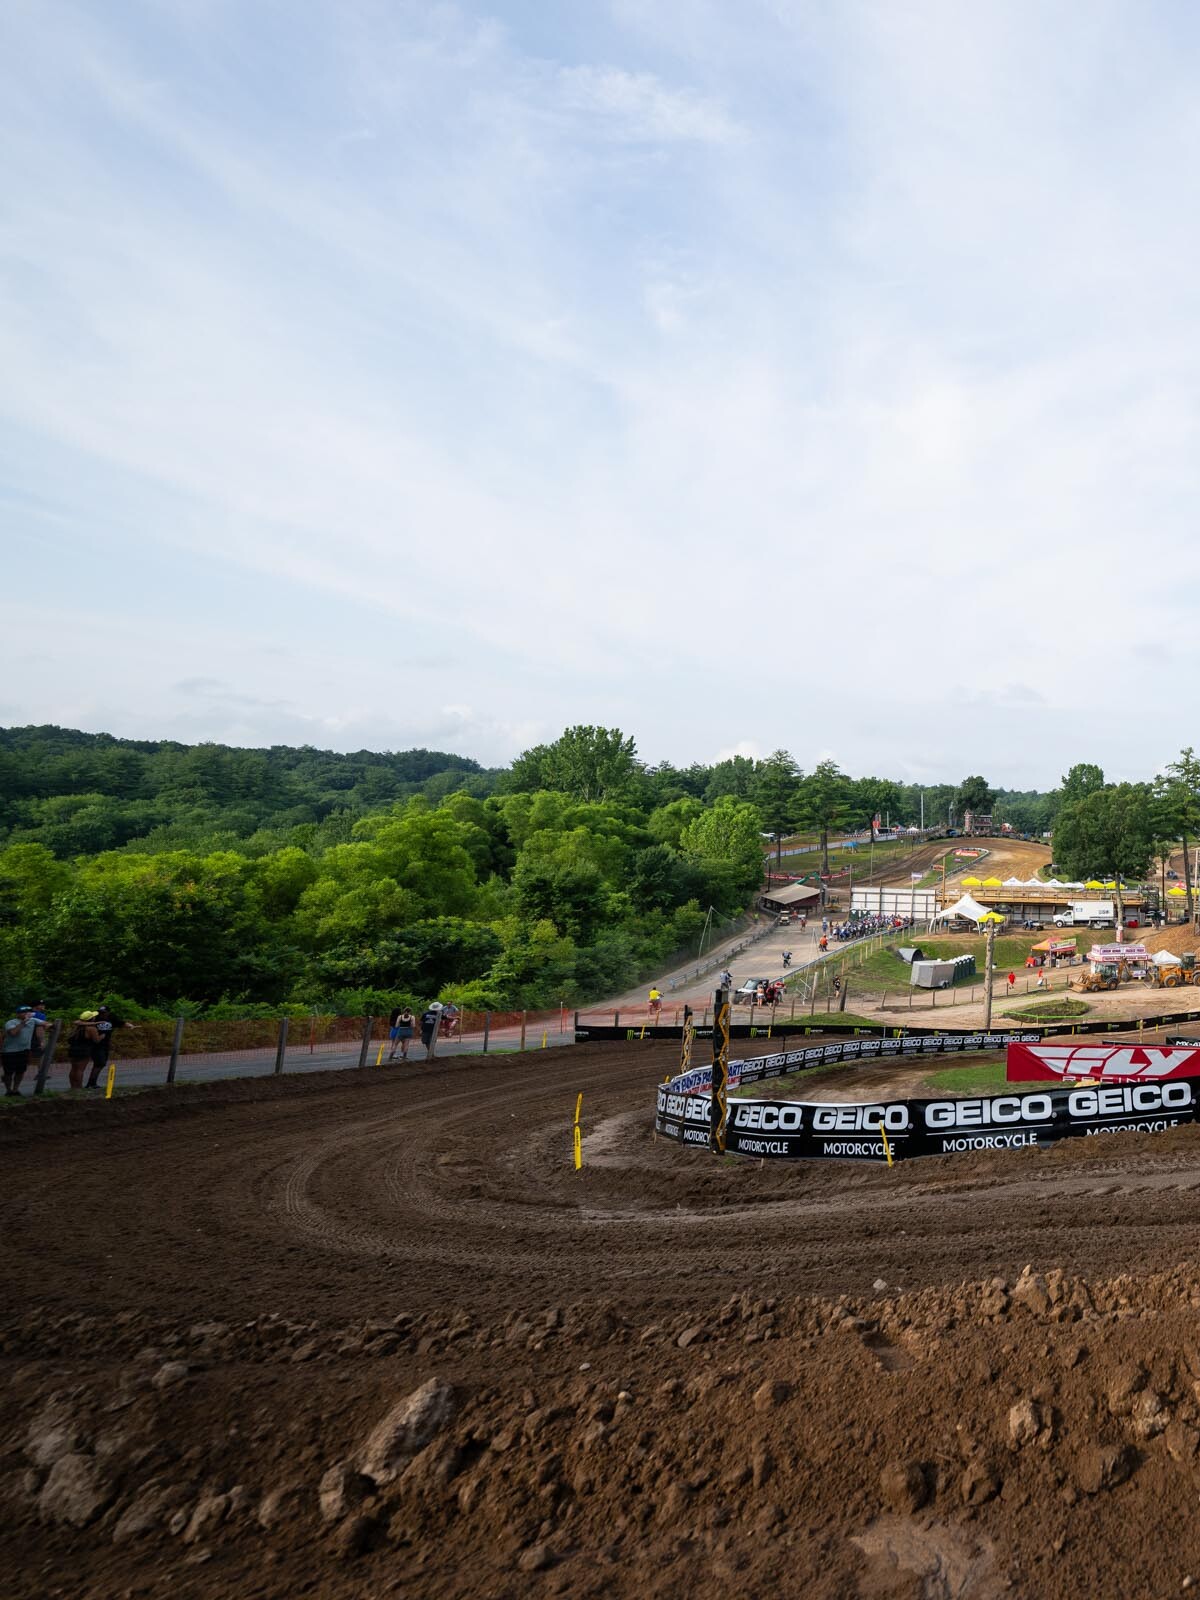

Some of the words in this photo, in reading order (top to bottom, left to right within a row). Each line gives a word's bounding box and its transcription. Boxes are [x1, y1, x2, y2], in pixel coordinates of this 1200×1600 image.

[742, 1060, 763, 1073] GEICO
[765, 1055, 785, 1068] GEICO
[786, 1051, 804, 1063] GEICO
[805, 1048, 823, 1060] GEICO
[824, 1045, 842, 1055] GEICO
[843, 1042, 860, 1052] GEICO
[861, 1041, 880, 1049] GEICO
[881, 1040, 900, 1048] GEICO
[902, 1039, 921, 1047] GEICO
[923, 1038, 942, 1046] GEICO
[1026, 1046, 1197, 1075] FLY
[734, 1105, 803, 1130] GEICO
[812, 1105, 909, 1130] GEICO
[925, 1094, 1053, 1128] GEICO
[1069, 1082, 1192, 1117] GEICO
[684, 1129, 710, 1143] MOTORCY
[738, 1139, 789, 1154] MOTORCYCLE
[824, 1142, 895, 1155] MOTORCYCLE
[942, 1133, 1038, 1152] MOTORCYCLE
